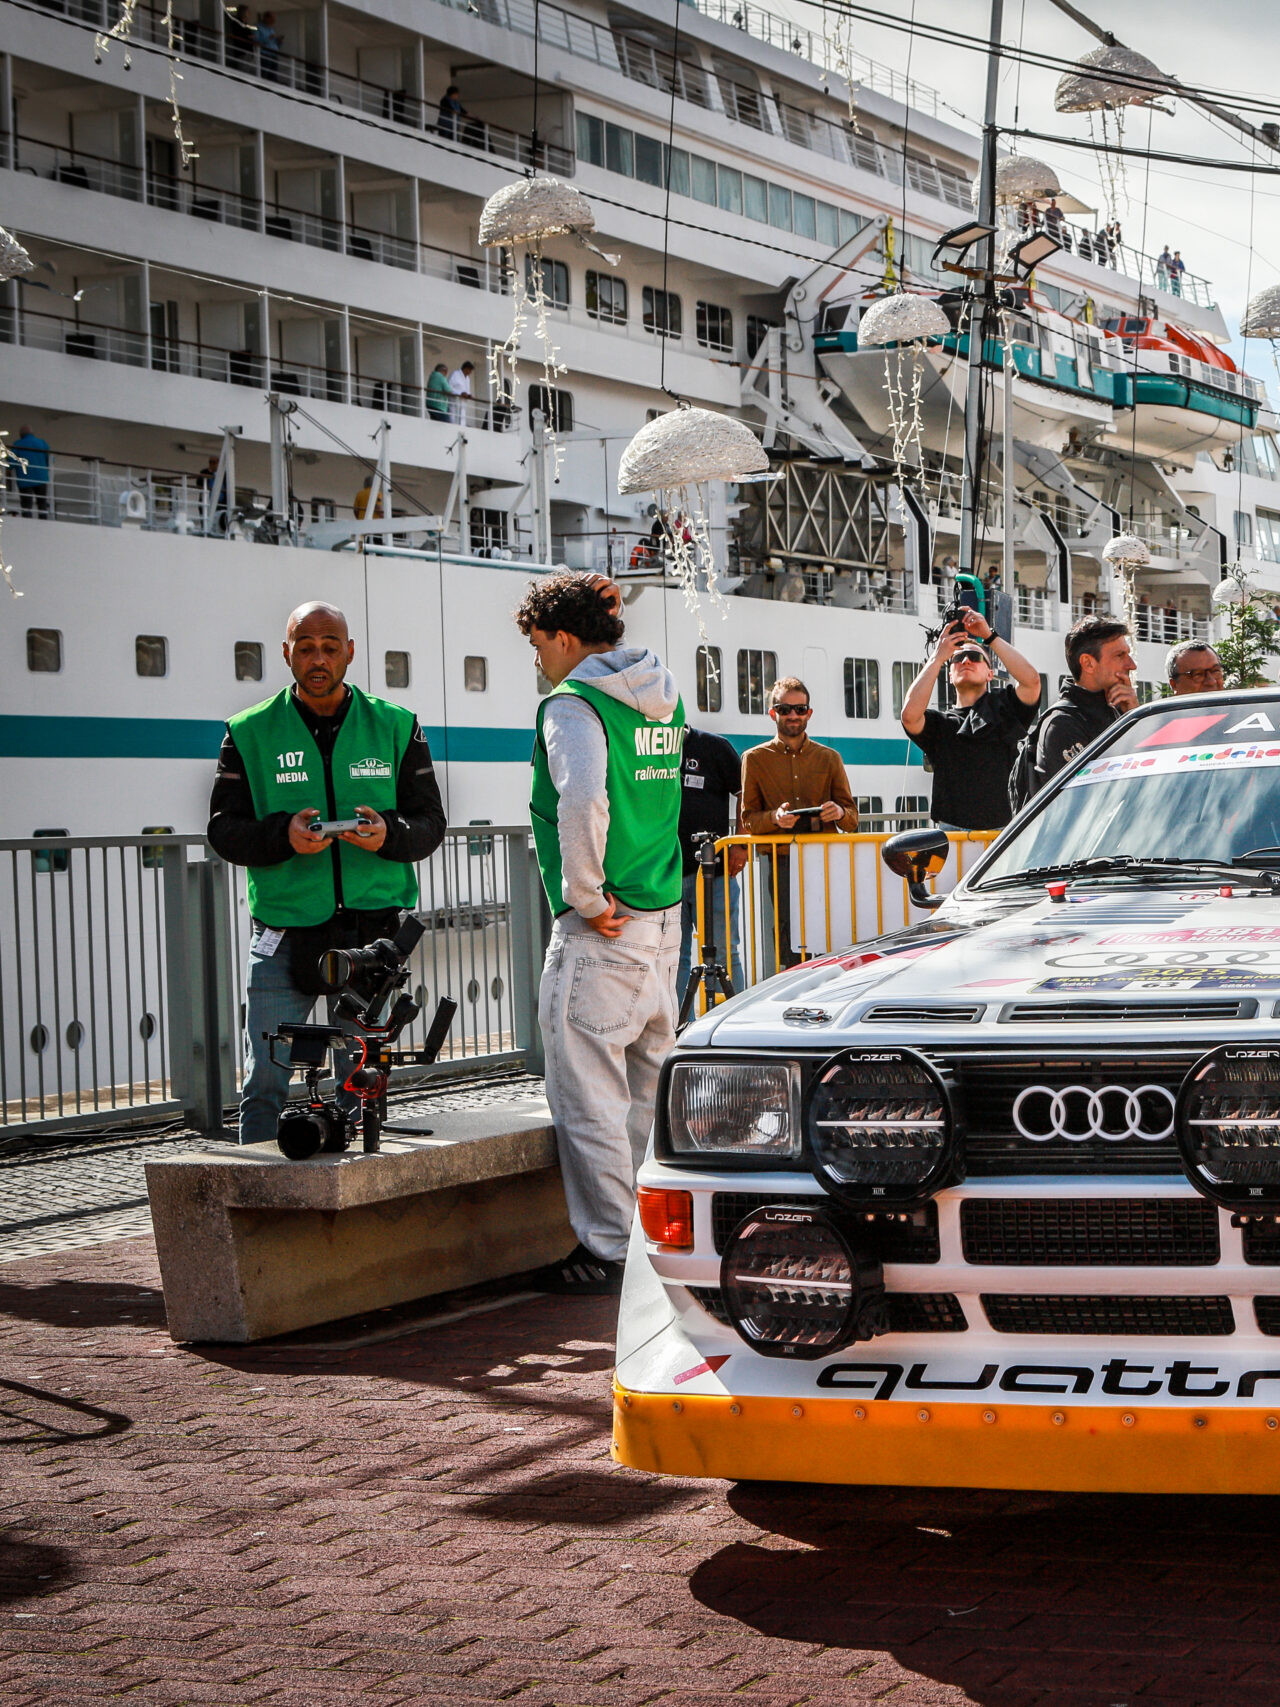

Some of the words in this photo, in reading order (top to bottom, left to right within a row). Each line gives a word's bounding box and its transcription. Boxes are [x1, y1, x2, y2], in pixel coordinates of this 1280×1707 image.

[1027, 353, 1033, 370] 4
[277, 751, 305, 768] 107
[1076, 757, 1156, 776] adeira
[276, 771, 309, 784] MEDIA
[1191, 927, 1276, 936] 1984
[1187, 934, 1254, 942] MONTE
[1135, 968, 1230, 976] 2025
[849, 1054, 902, 1062] LAZER
[1225, 1050, 1280, 1059] LAZER
[764, 1212, 813, 1223] LAZER
